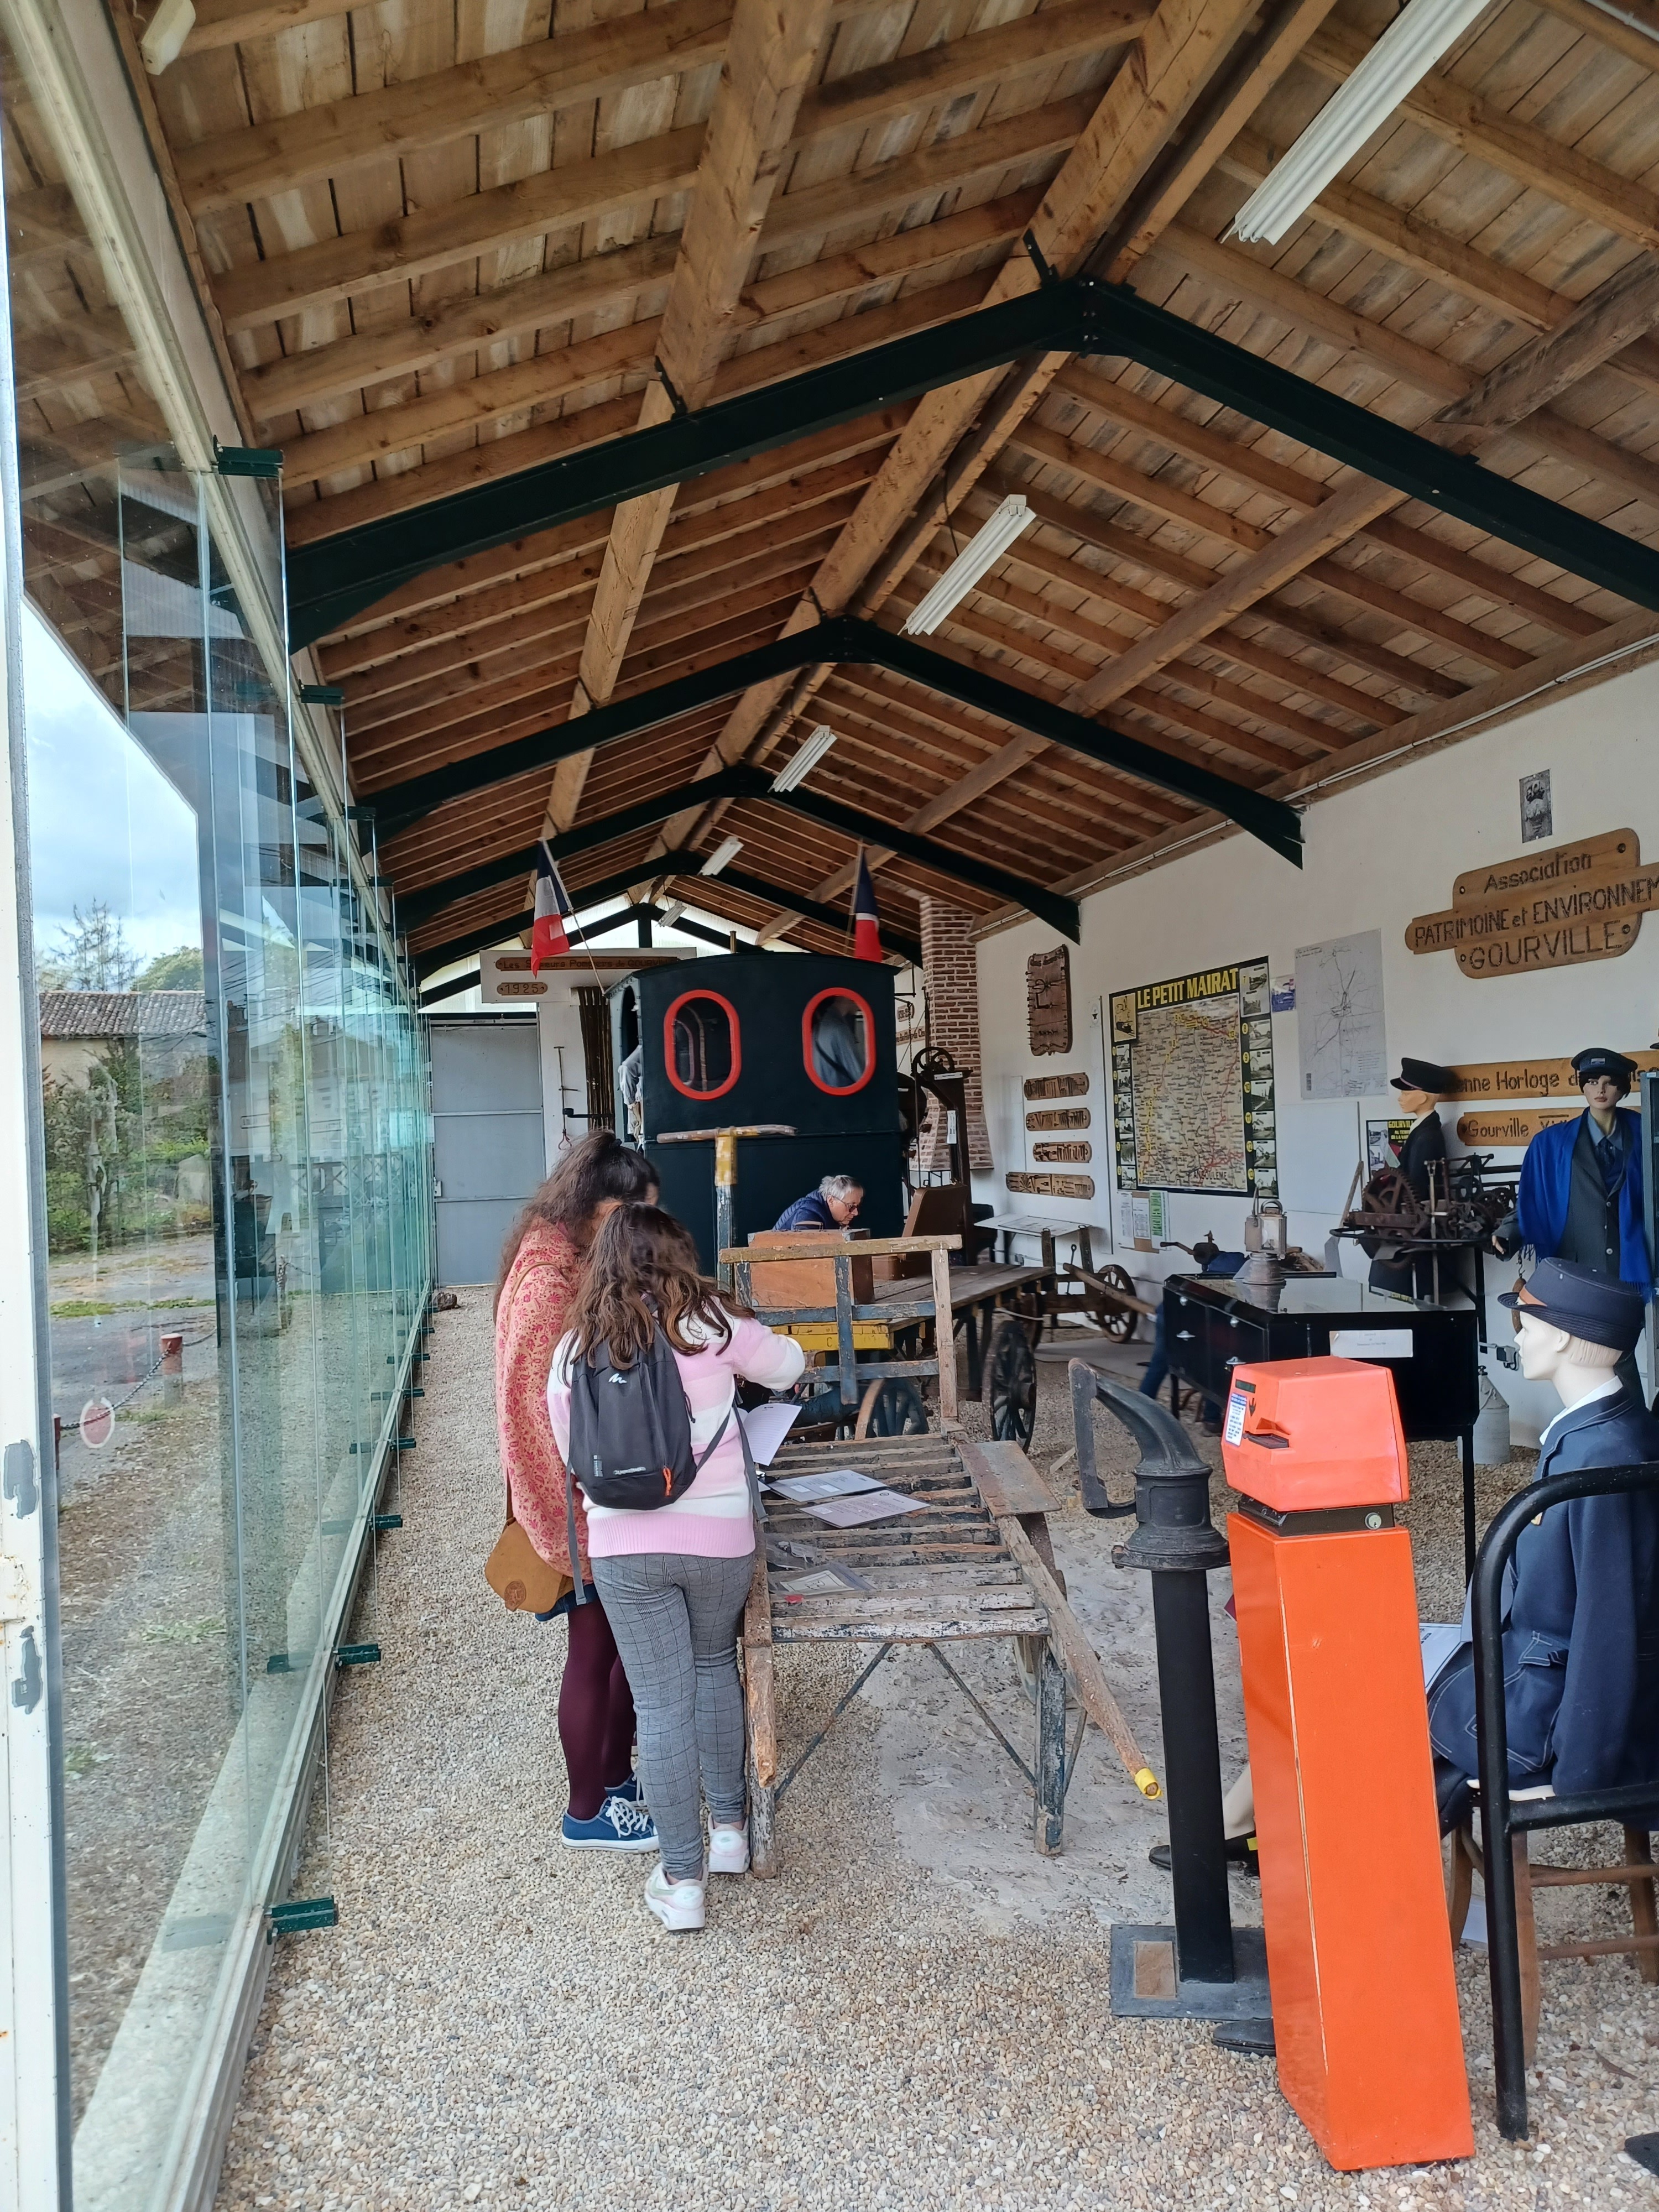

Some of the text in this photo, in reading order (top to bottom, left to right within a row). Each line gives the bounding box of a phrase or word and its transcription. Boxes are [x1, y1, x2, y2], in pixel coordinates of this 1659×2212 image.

[1484, 852, 1592, 894] Association
[1415, 907, 1510, 948] PATRIMOINE
[1512, 907, 1528, 927] et
[1469, 919, 1623, 971] GOURVILLE
[504, 961, 520, 969] Les
[525, 959, 566, 969] Speurs
[570, 959, 613, 969] Pompers
[504, 983, 539, 994] 1925
[1137, 968, 1238, 1009] LE PETIT MAIRAT
[1496, 1068, 1559, 1097] Horloge
[1467, 1117, 1529, 1138] Gourville
